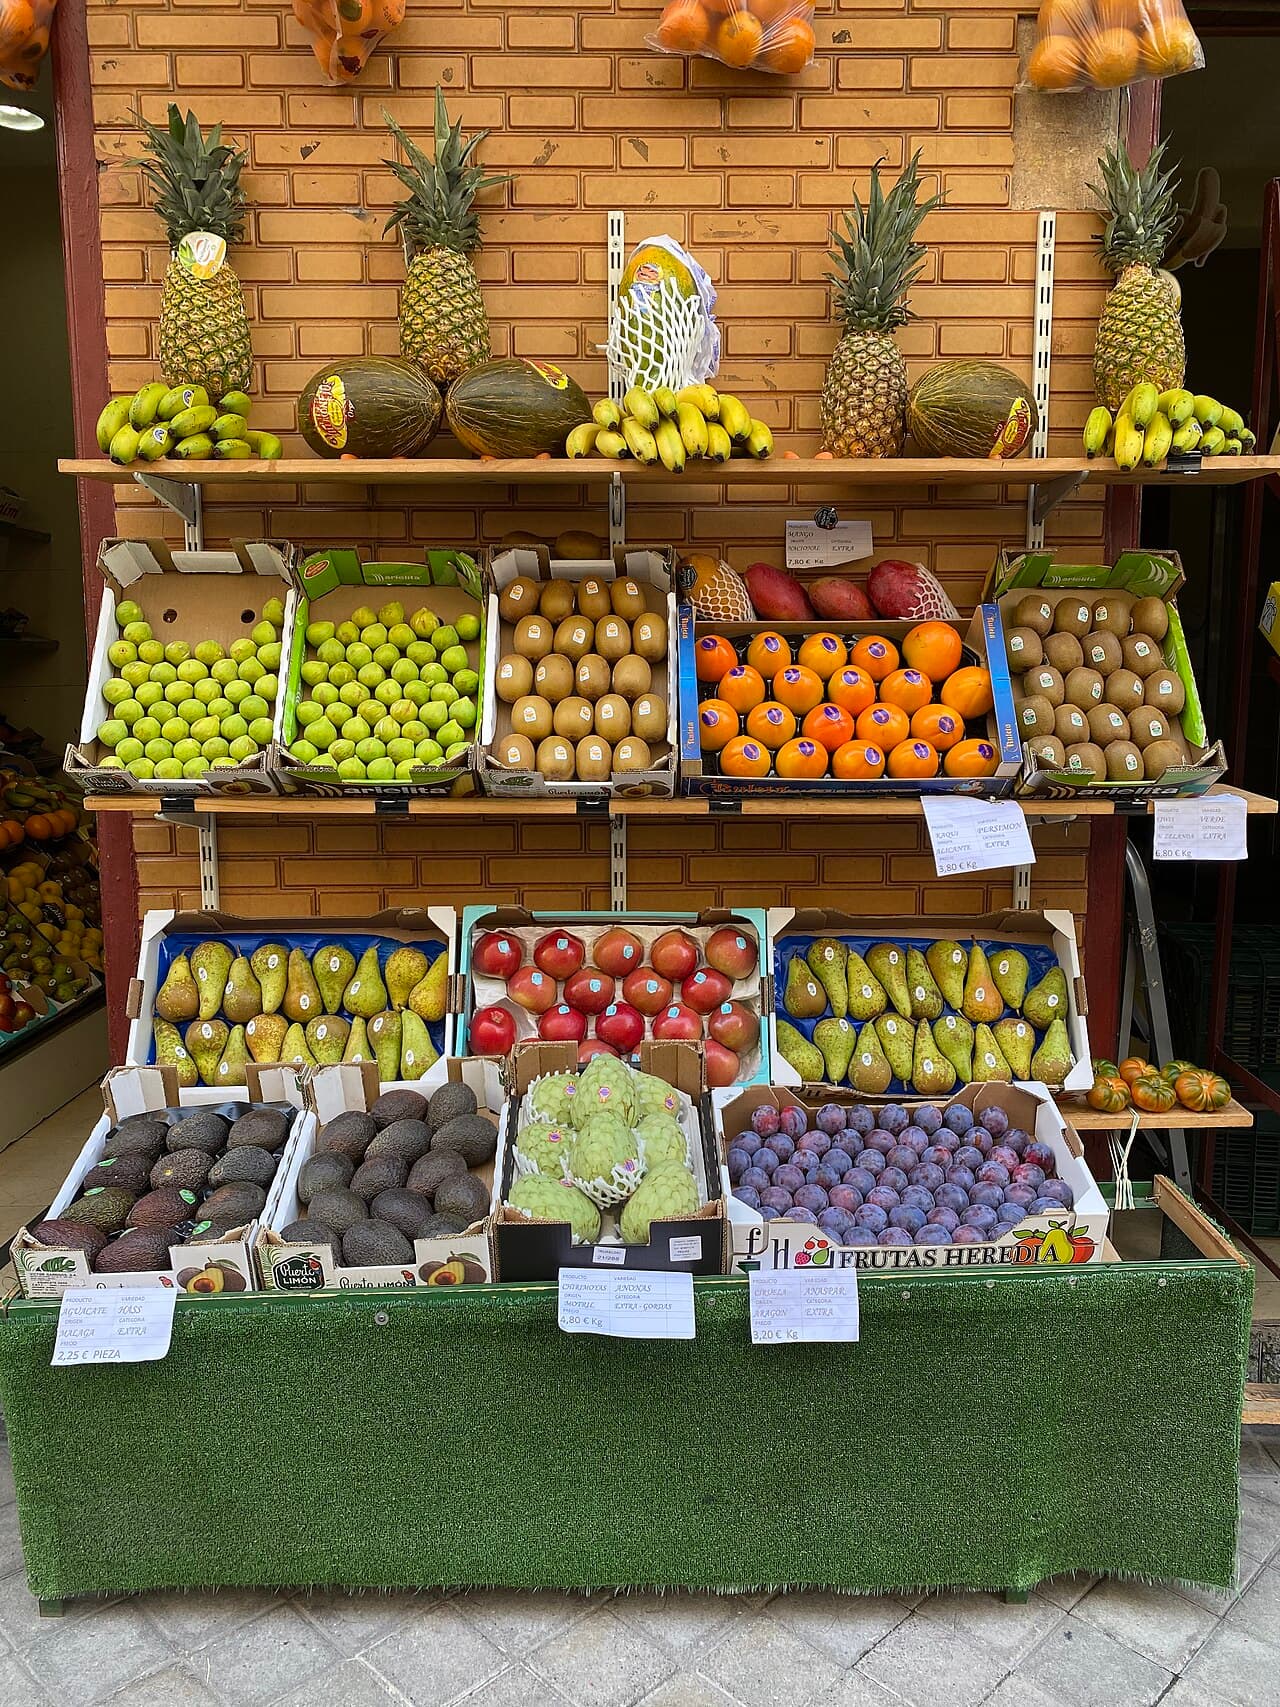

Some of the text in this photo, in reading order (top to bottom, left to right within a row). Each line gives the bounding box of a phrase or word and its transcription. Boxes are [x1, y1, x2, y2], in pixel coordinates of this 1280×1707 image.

[977, 822, 1022, 834] PERSIMON
[936, 840, 1010, 854] ALICANTE EXTRA
[1182, 850, 1192, 858] Kg
[938, 863, 958, 874] 3,80
[966, 861, 978, 870] Kg
[839, 1244, 1058, 1269] FRUTAS HEREDIA
[280, 1262, 315, 1277] Puerto
[614, 1284, 652, 1292] ANONAS
[564, 1300, 596, 1309] MOTRIL
[62, 1306, 143, 1317] AGUACATE HASS
[805, 1308, 834, 1316] EXTRA
[560, 1315, 581, 1325] 4,80
[592, 1317, 603, 1328] Kg
[59, 1326, 147, 1338] MALAGA EXTRA
[753, 1330, 799, 1340] 3,20 € Kg
[57, 1350, 121, 1361] 2,25 € PIEZA
